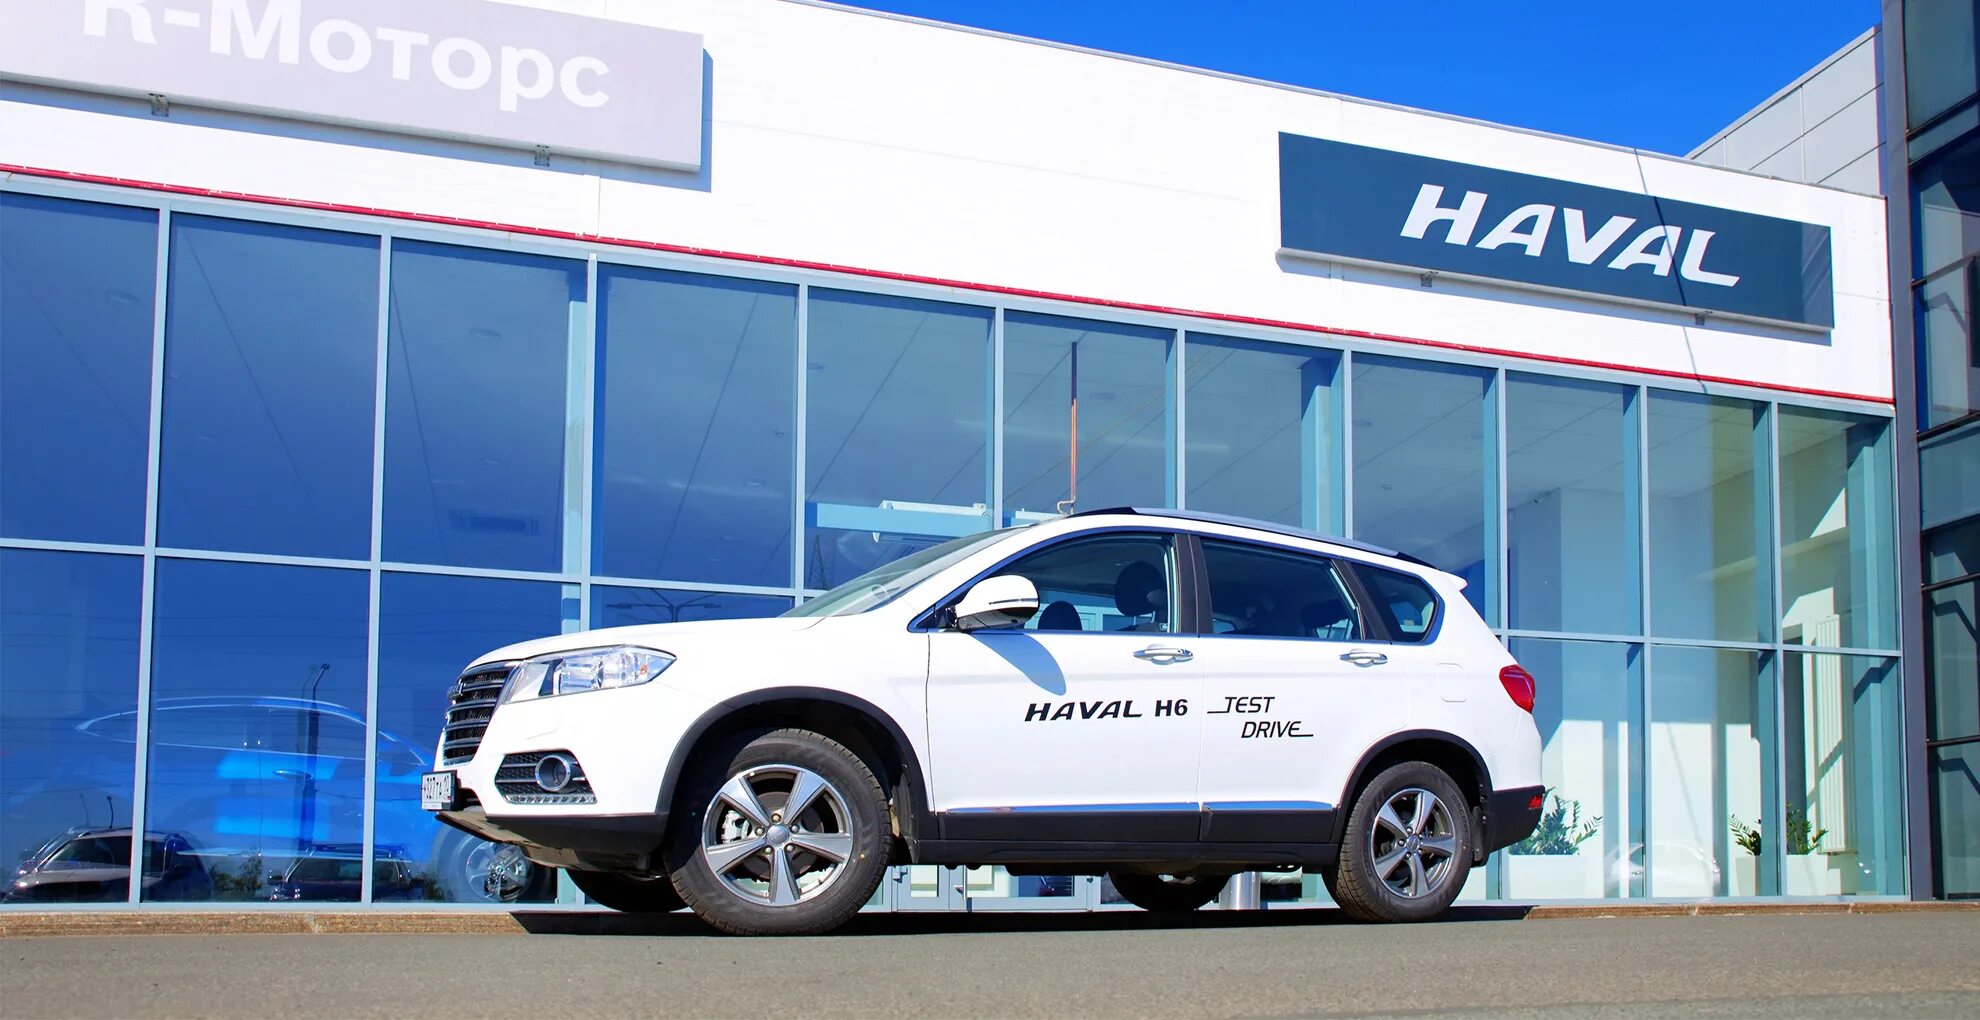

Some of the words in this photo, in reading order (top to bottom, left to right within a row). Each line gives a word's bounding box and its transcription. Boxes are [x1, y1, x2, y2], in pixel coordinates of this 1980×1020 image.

[1400, 183, 1741, 287] HAVAL
[1024, 700, 1143, 722] HAVAL
[1155, 698, 1188, 717] H6
[1207, 696, 1275, 714] TEST
[1241, 721, 1314, 738] DRIVE
